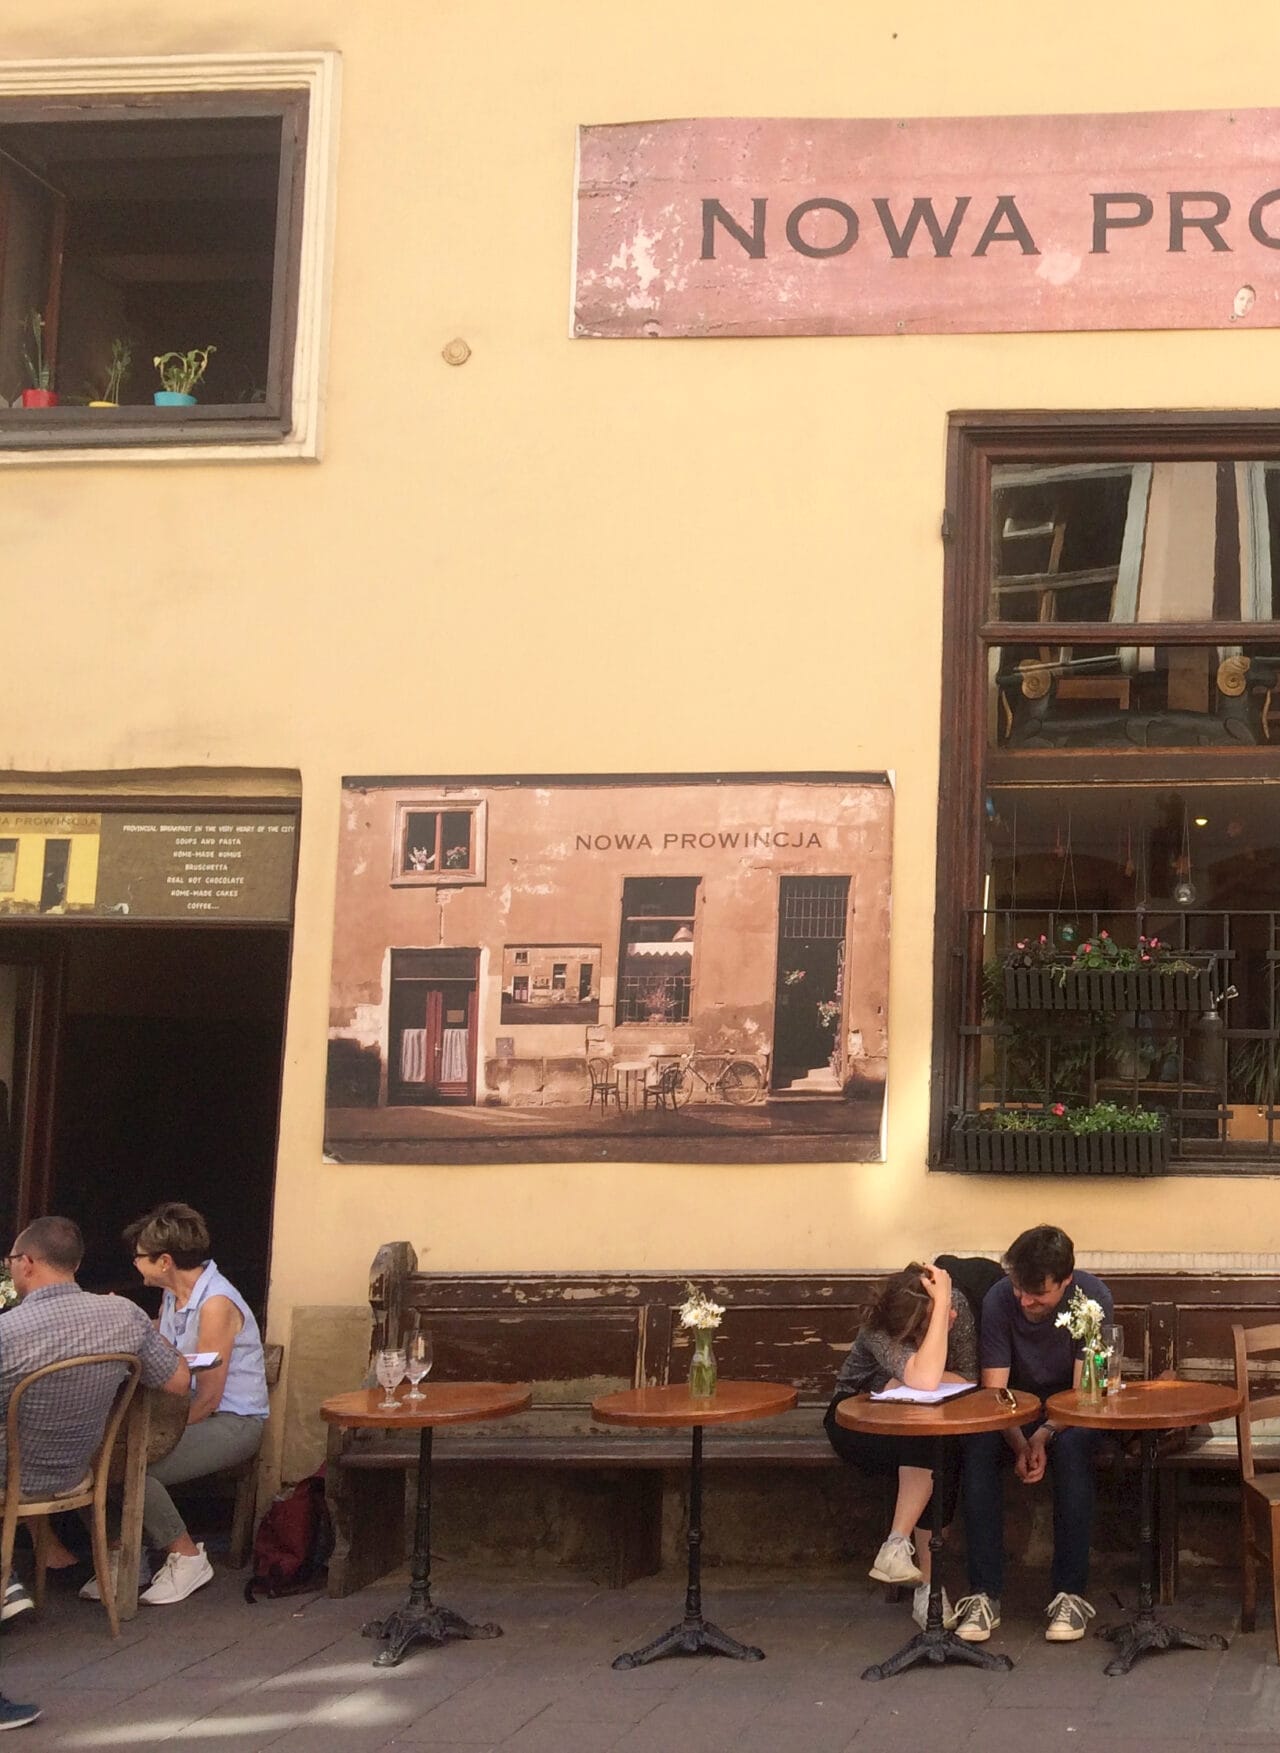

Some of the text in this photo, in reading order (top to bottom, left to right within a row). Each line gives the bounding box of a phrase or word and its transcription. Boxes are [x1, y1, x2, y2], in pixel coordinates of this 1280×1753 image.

[700, 194, 1041, 260] NOWA
[194, 825, 203, 833] IN
[205, 825, 217, 833] THE
[267, 825, 279, 833] THE
[281, 825, 295, 833] CITY
[575, 832, 823, 851] NOWA PROWINCJA
